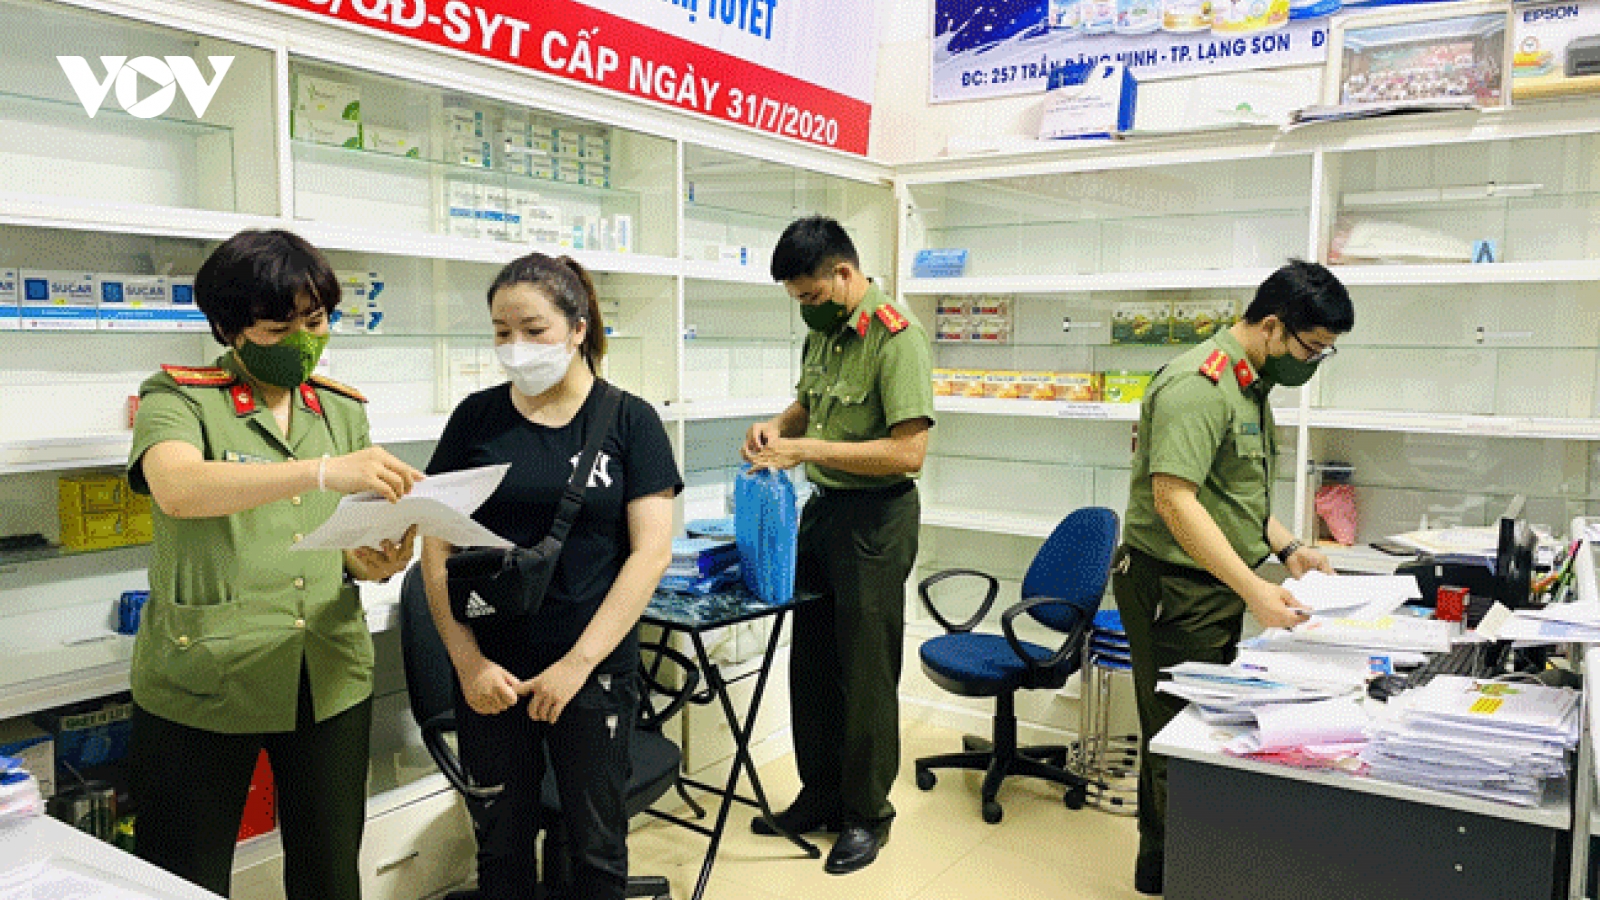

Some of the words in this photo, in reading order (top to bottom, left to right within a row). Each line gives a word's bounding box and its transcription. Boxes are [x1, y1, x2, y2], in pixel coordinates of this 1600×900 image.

[1523, 5, 1578, 22] EPSON
[992, 65, 1017, 83] 257
[1171, 45, 1192, 62] TP.
[1198, 38, 1246, 63] LẠNG
[541, 26, 619, 82] CẤP
[629, 55, 720, 111] NGÀY
[726, 87, 838, 146] 31/7/2020
[51, 281, 92, 294] SUCAR
